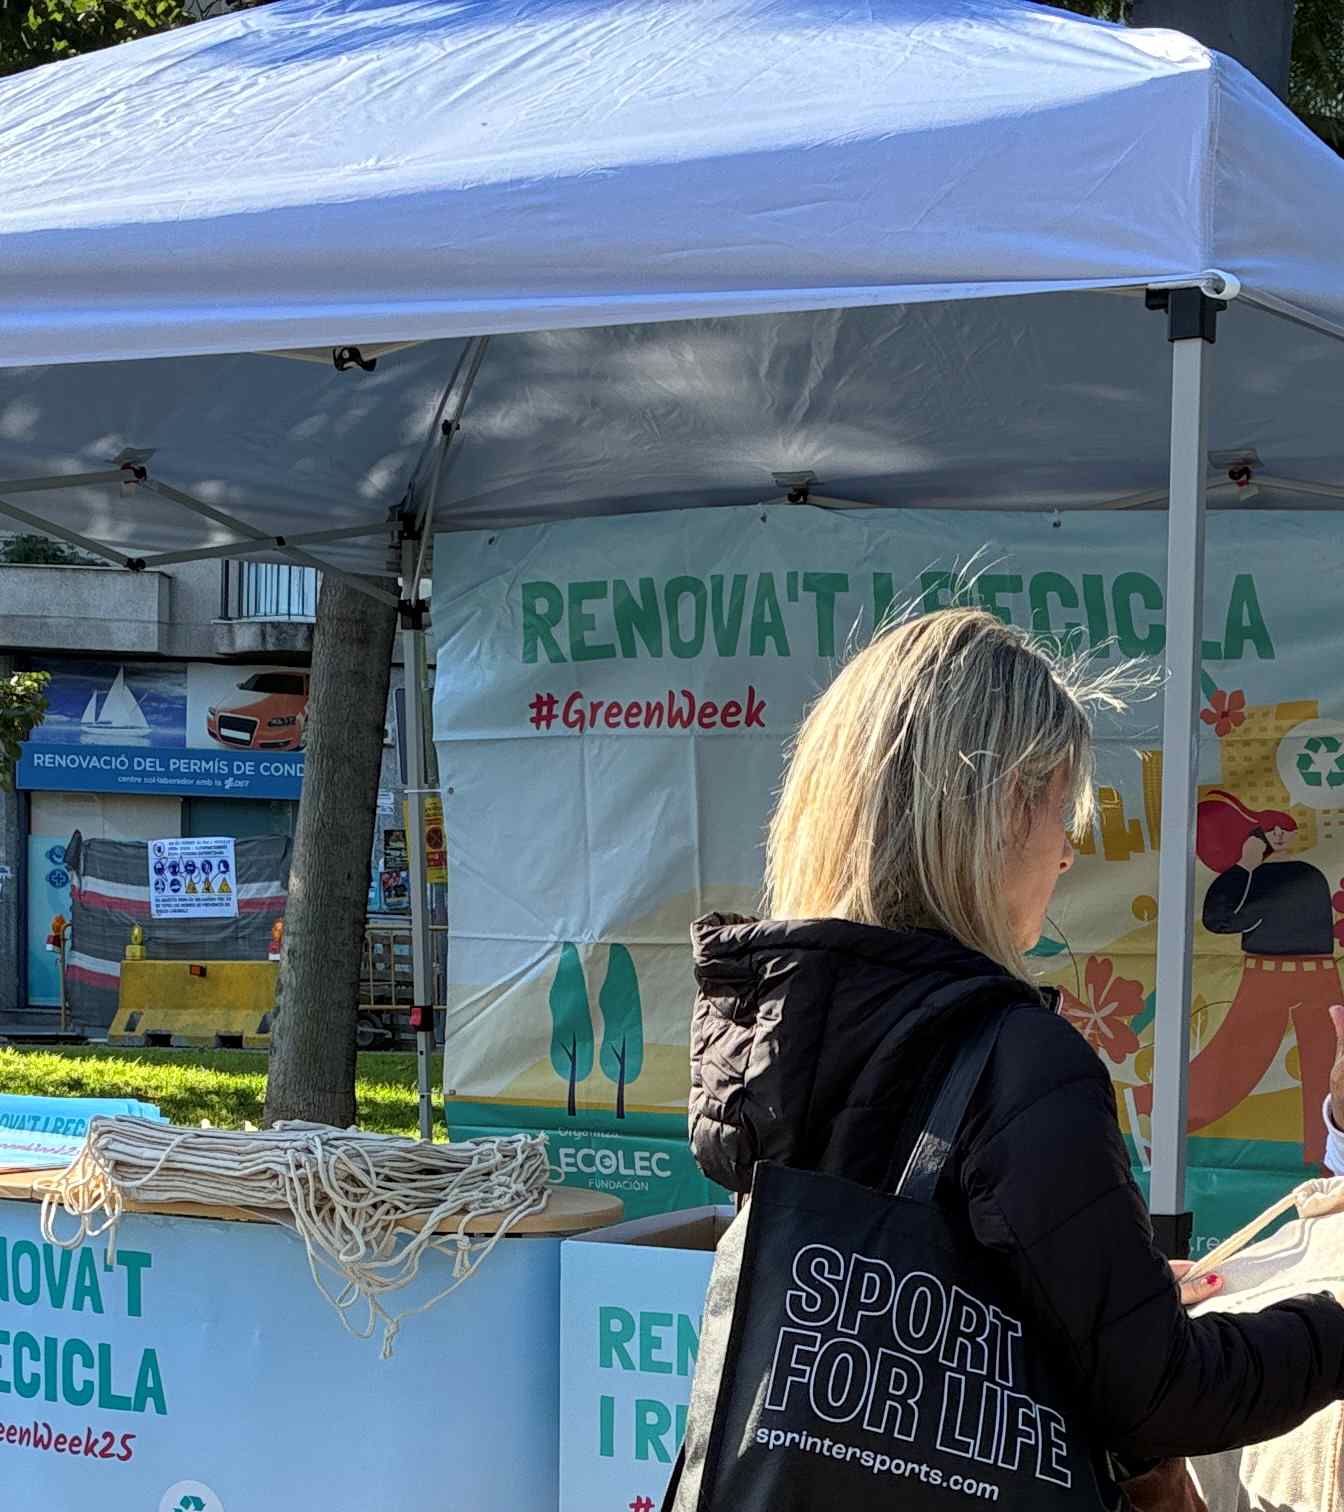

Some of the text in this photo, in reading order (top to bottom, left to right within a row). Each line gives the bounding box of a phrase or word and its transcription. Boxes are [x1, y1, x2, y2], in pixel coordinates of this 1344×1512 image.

[520, 572, 850, 665] RENOVA'T
[529, 685, 767, 733] #GreenWeek
[34, 754, 129, 770] RENOVACIÓ
[134, 758, 165, 772] DEL
[170, 757, 228, 774] PERMÍS
[233, 761, 255, 775] DE
[559, 1148, 672, 1178] ECOLEC
[588, 1176, 649, 1192] FUNDACIÓN
[785, 1243, 1022, 1386] SPORT
[600, 1395, 614, 1457] I
[765, 1328, 1072, 1488] FOR LIFE
[756, 1426, 1000, 1502] sprintersports.com
